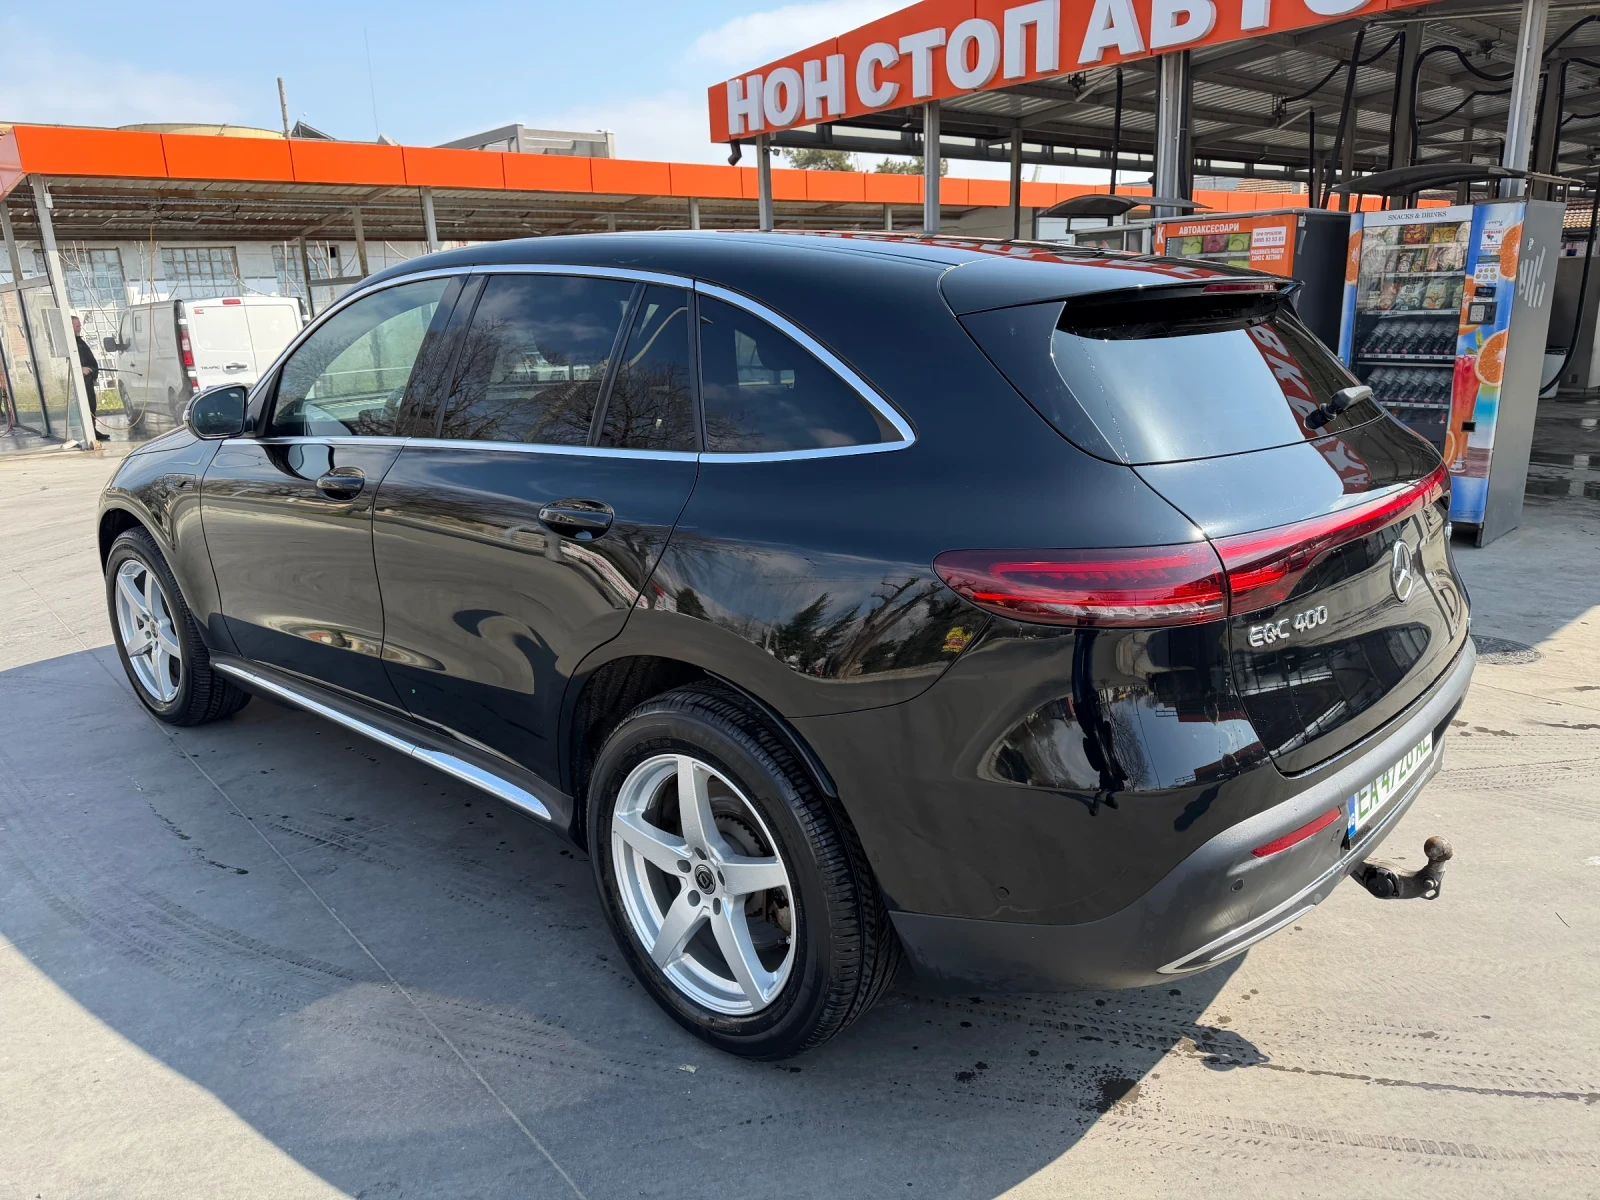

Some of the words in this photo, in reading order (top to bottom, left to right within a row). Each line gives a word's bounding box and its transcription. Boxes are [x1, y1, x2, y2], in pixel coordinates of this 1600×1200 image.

[726, 53, 846, 135] НОН
[856, 0, 1061, 108] СТОП
[1178, 222, 1240, 235] АВТОАКСЕСОАРИ
[1249, 618, 1290, 647] EQC
[1294, 605, 1328, 632] 400
